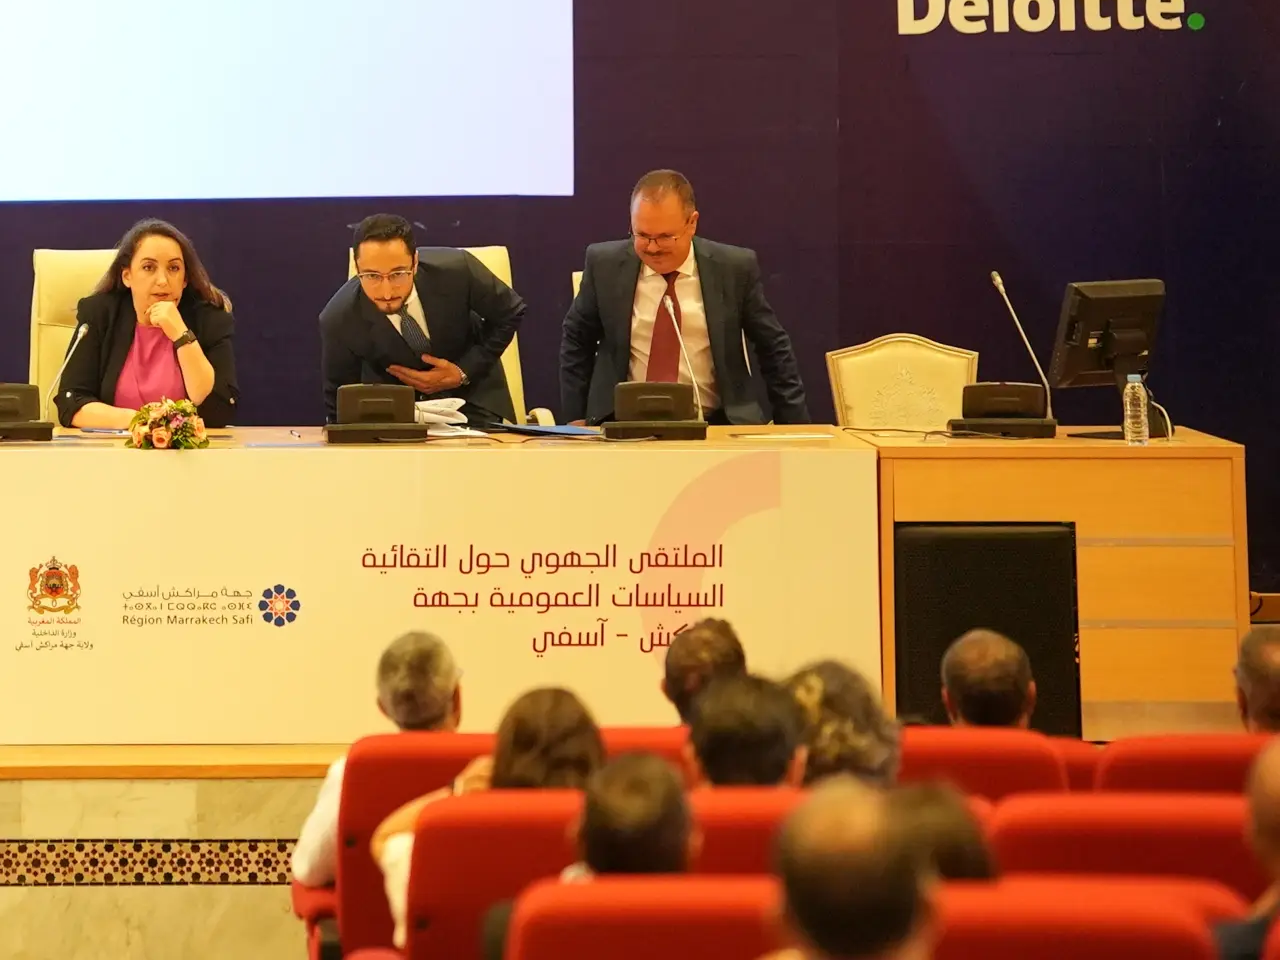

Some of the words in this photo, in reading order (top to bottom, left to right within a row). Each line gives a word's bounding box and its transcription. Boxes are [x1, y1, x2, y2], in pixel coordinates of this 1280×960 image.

[362, 544, 446, 574] التقائية
[459, 544, 509, 574] حول
[521, 544, 616, 578] الجهوي
[630, 544, 722, 573] الملتقى
[414, 588, 478, 613] بجهة
[490, 584, 599, 613] العمومية
[612, 584, 723, 613] السياسات
[122, 614, 163, 628] Région
[166, 614, 228, 625] Marrakech
[232, 614, 253, 625] Safi
[35, 640, 58, 651] مراكش
[533, 617, 608, 657] آسفي
